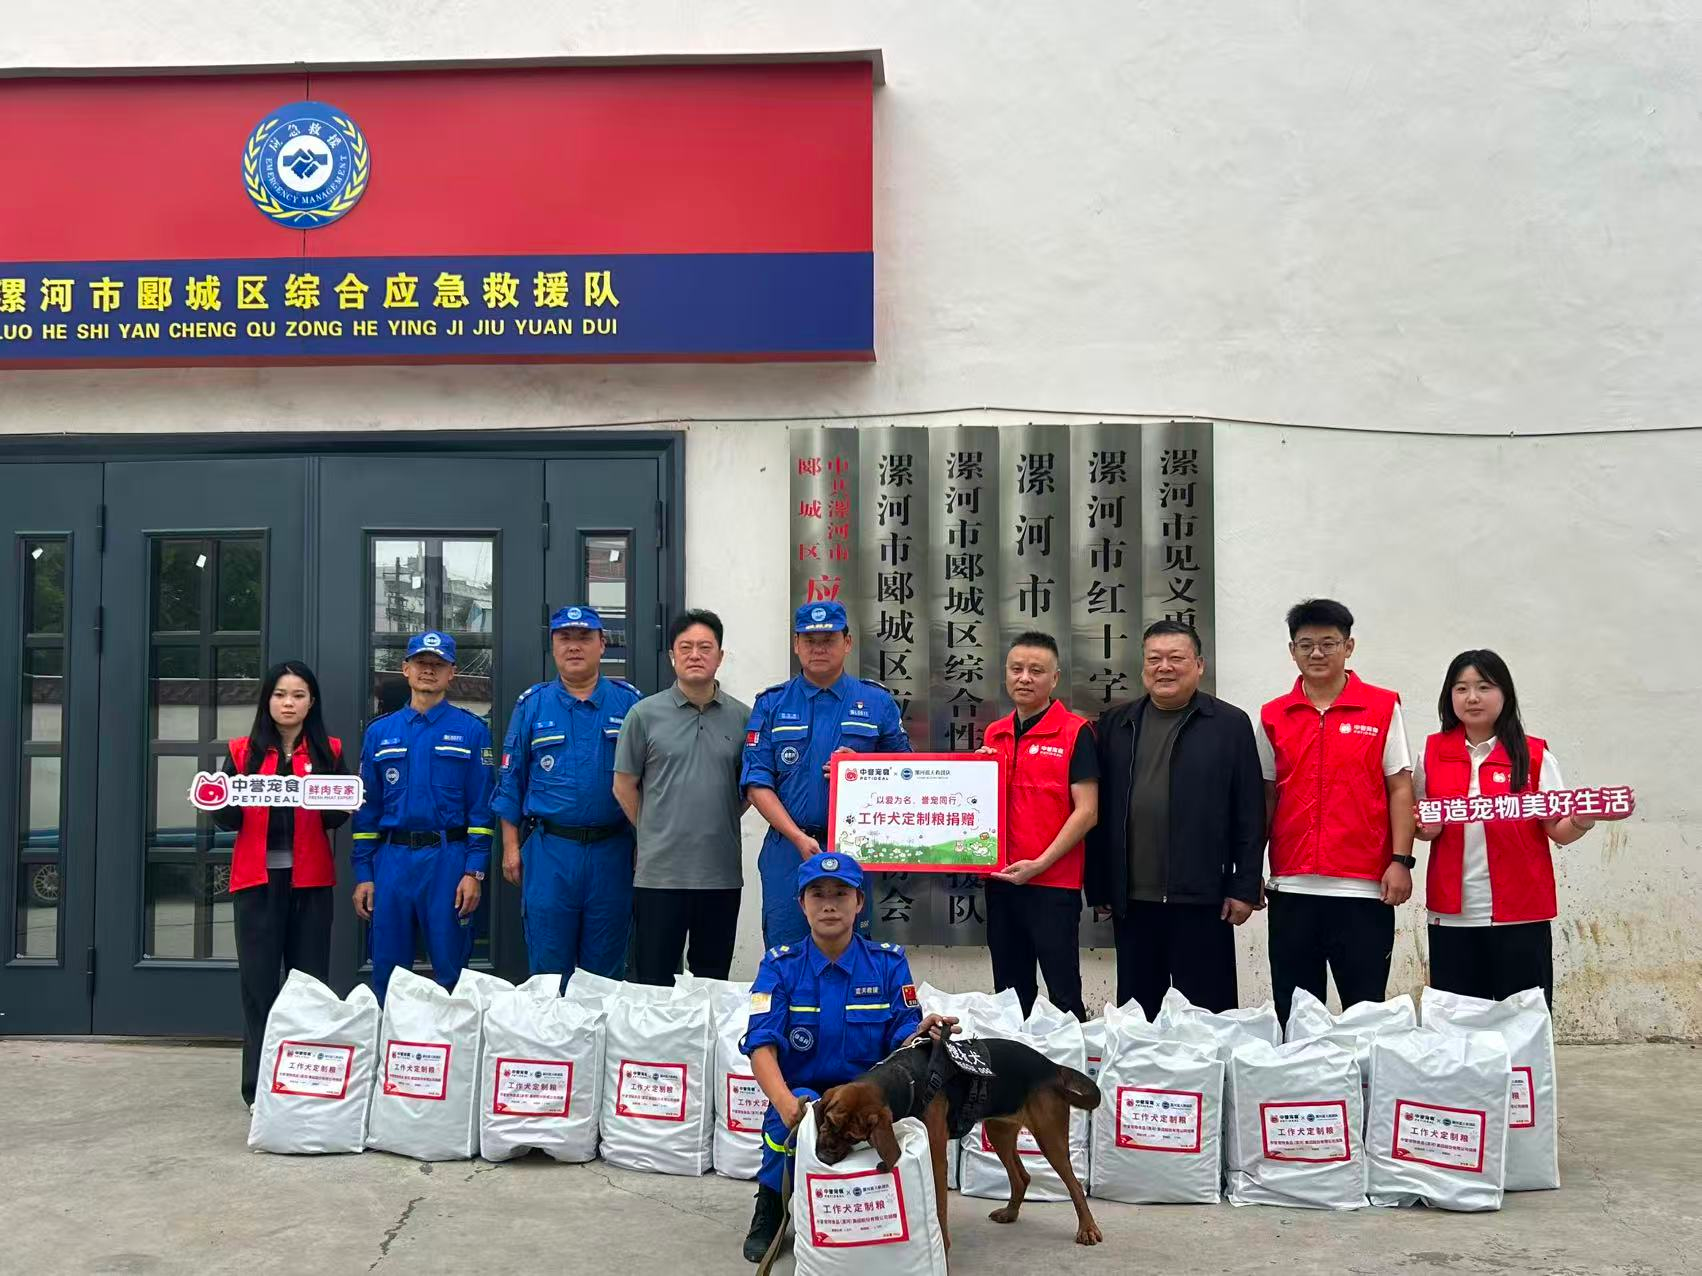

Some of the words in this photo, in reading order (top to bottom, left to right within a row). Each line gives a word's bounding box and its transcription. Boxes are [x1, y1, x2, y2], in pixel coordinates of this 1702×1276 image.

[268, 122, 342, 152] 应急救援
[266, 157, 299, 204] EMERGENCY
[301, 155, 348, 204] MANAGEMENT
[0, 271, 620, 313] 漯河市郾城区综合应急救援队
[0, 324, 32, 340] UO
[42, 324, 67, 340] HE
[77, 323, 109, 339] SHI
[118, 323, 160, 339] YAN
[169, 322, 237, 338] CHENG
[246, 322, 276, 338] QU
[285, 320, 343, 337] ZONG
[353, 320, 378, 336] HE
[388, 320, 437, 336] YING
[446, 320, 463, 336] JI
[472, 320, 505, 335] JIU
[515, 319, 573, 335] YUAN
[582, 319, 617, 335] DUI
[798, 457, 822, 561] 郾城区
[1016, 452, 1055, 618] 漯河市
[1087, 450, 1128, 704] 漯河市红十字
[232, 778, 300, 793] 中誉宠食
[308, 784, 354, 795] 鲜肉专家
[232, 795, 299, 803] PETIDEAL
[1418, 788, 1630, 824] 智造宠物美好生活
[858, 811, 975, 827] 工作犬定制粮捐赠
[1278, 1126, 1334, 1136] 工作犬定制粮
[1410, 1126, 1469, 1143] 工作犬定制粮
[823, 1199, 886, 1214] 工作犬定制粮
